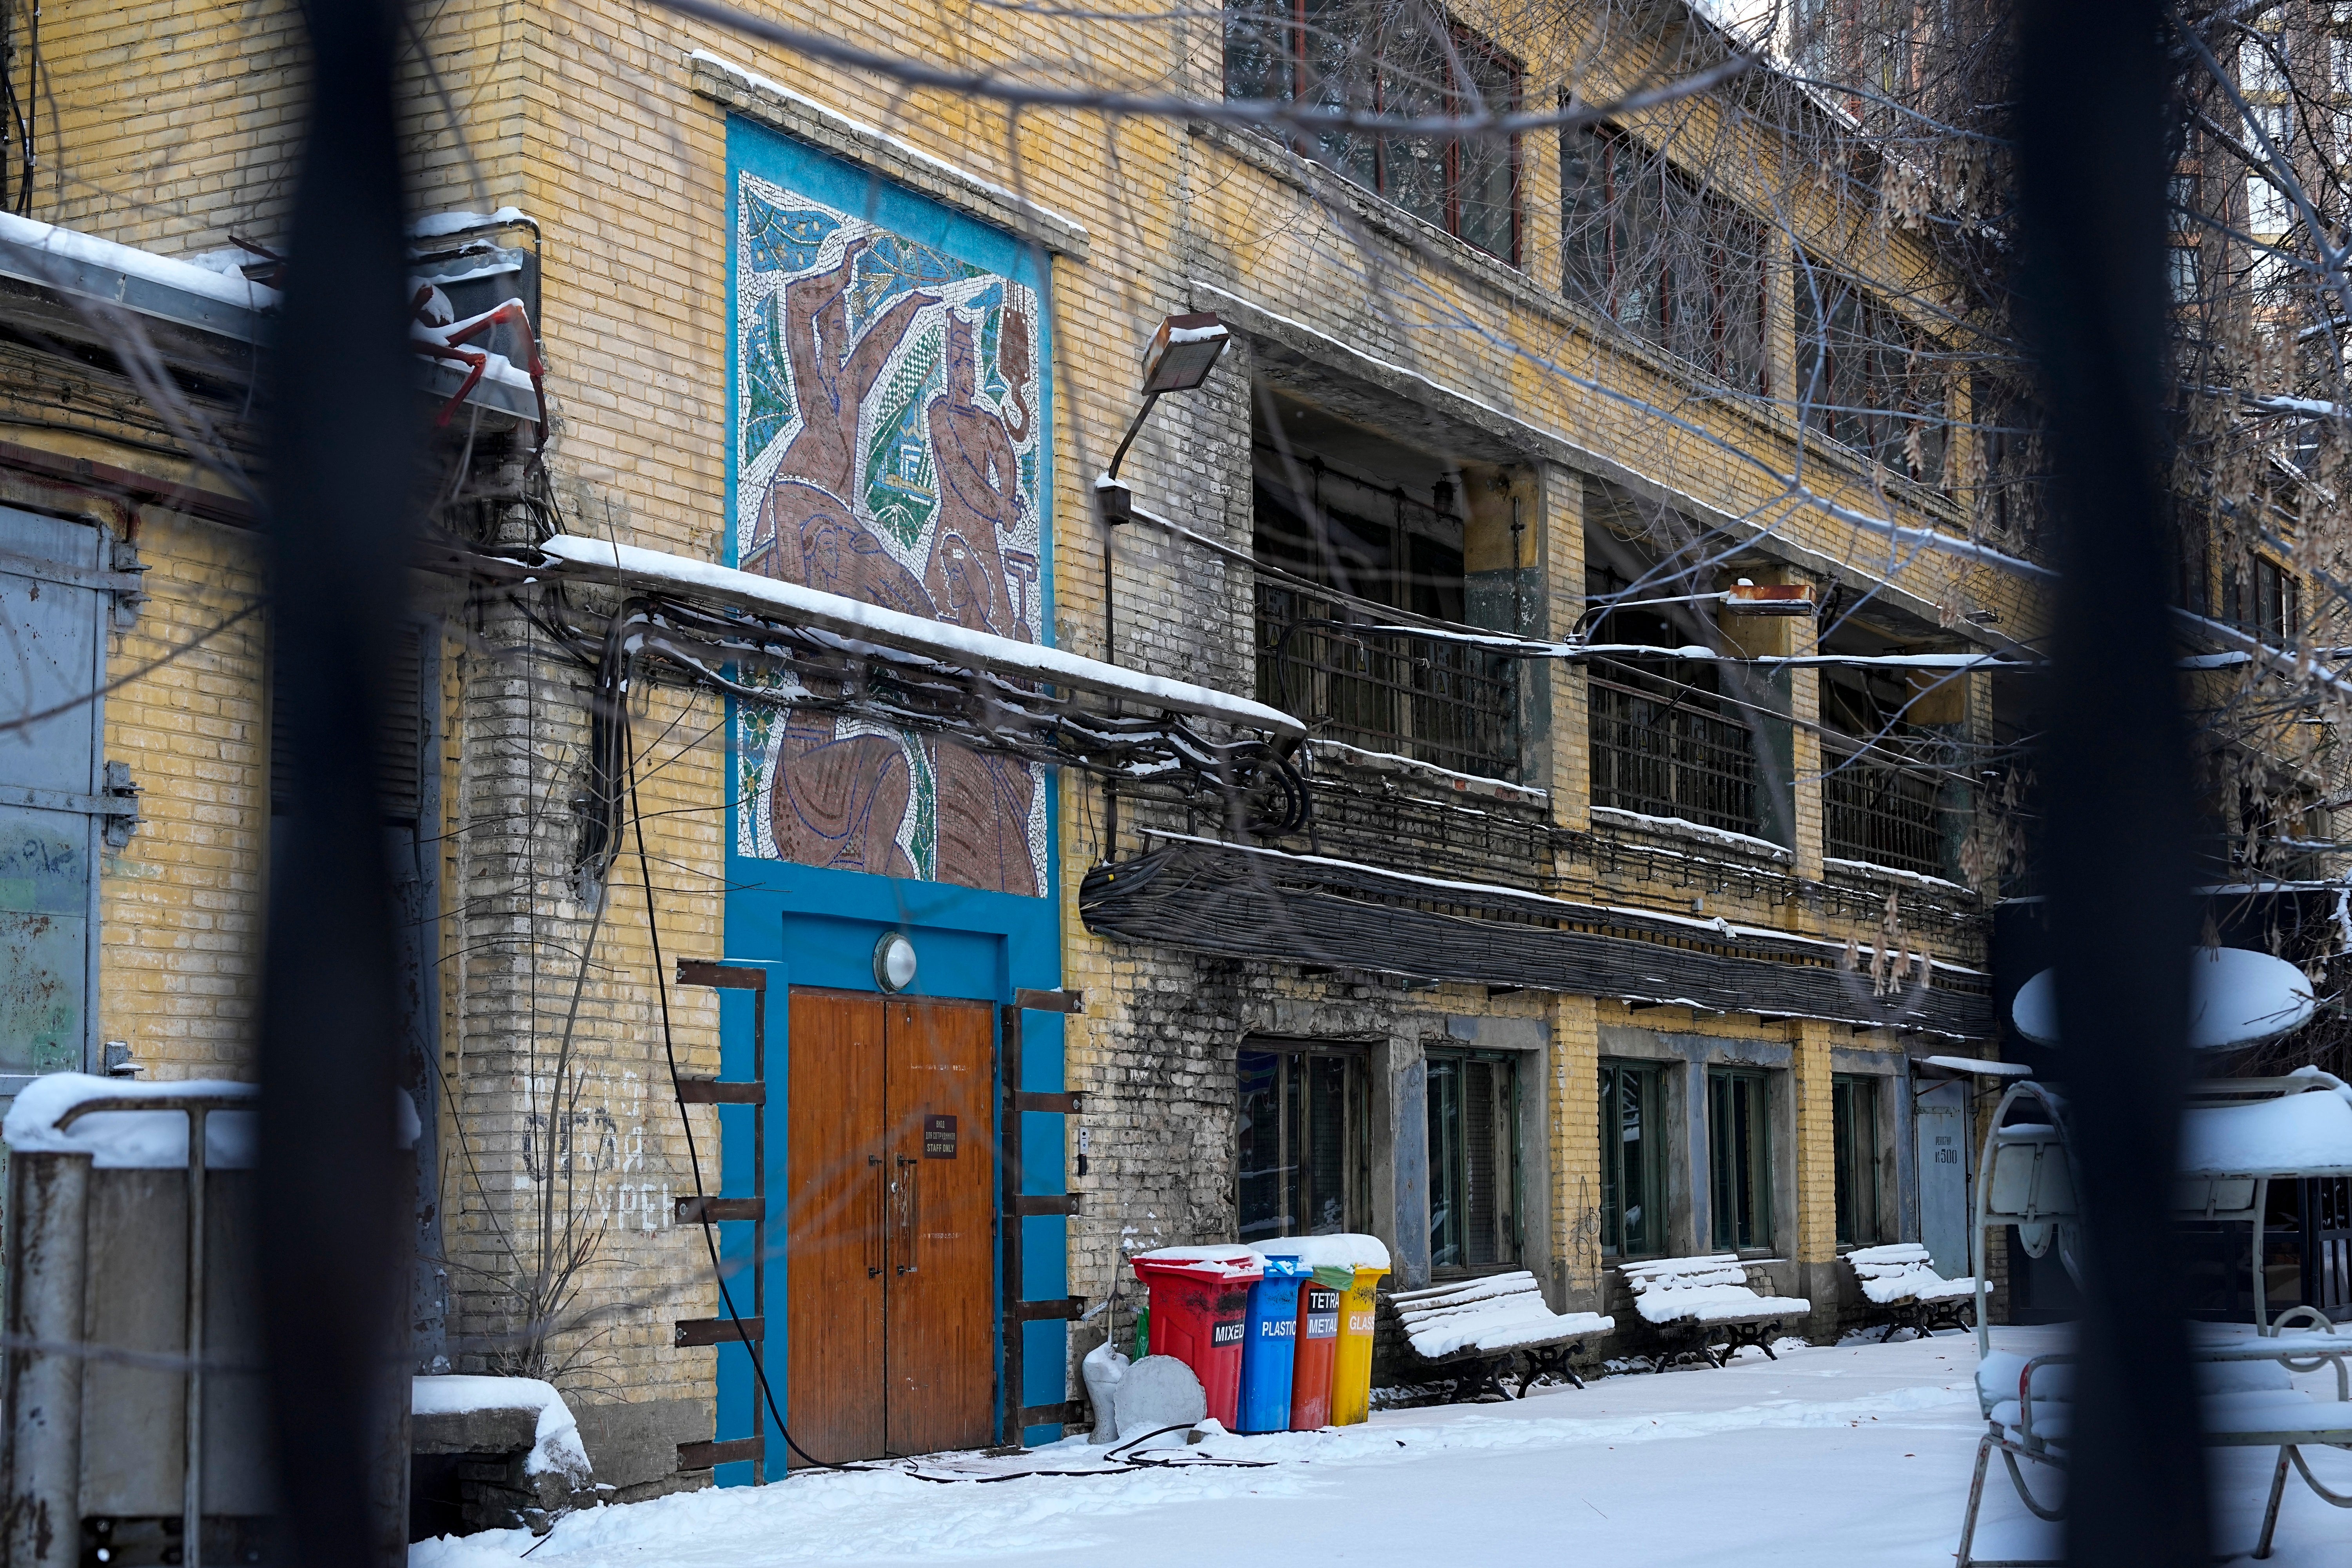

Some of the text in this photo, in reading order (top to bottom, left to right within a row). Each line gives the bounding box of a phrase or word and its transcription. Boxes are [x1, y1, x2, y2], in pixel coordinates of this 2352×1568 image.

[936, 1120, 945, 1129] ВХОД
[933, 1132, 955, 1140] СОТРУДНИКОВ
[927, 1143, 954, 1152] STAFF ONLY
[1310, 1292, 1339, 1308] TETRA
[1262, 1320, 1296, 1336] PLASTIC
[1309, 1318, 1338, 1334] METAL
[1349, 1316, 1375, 1330] GLASS
[1215, 1323, 1245, 1342] MIXED
